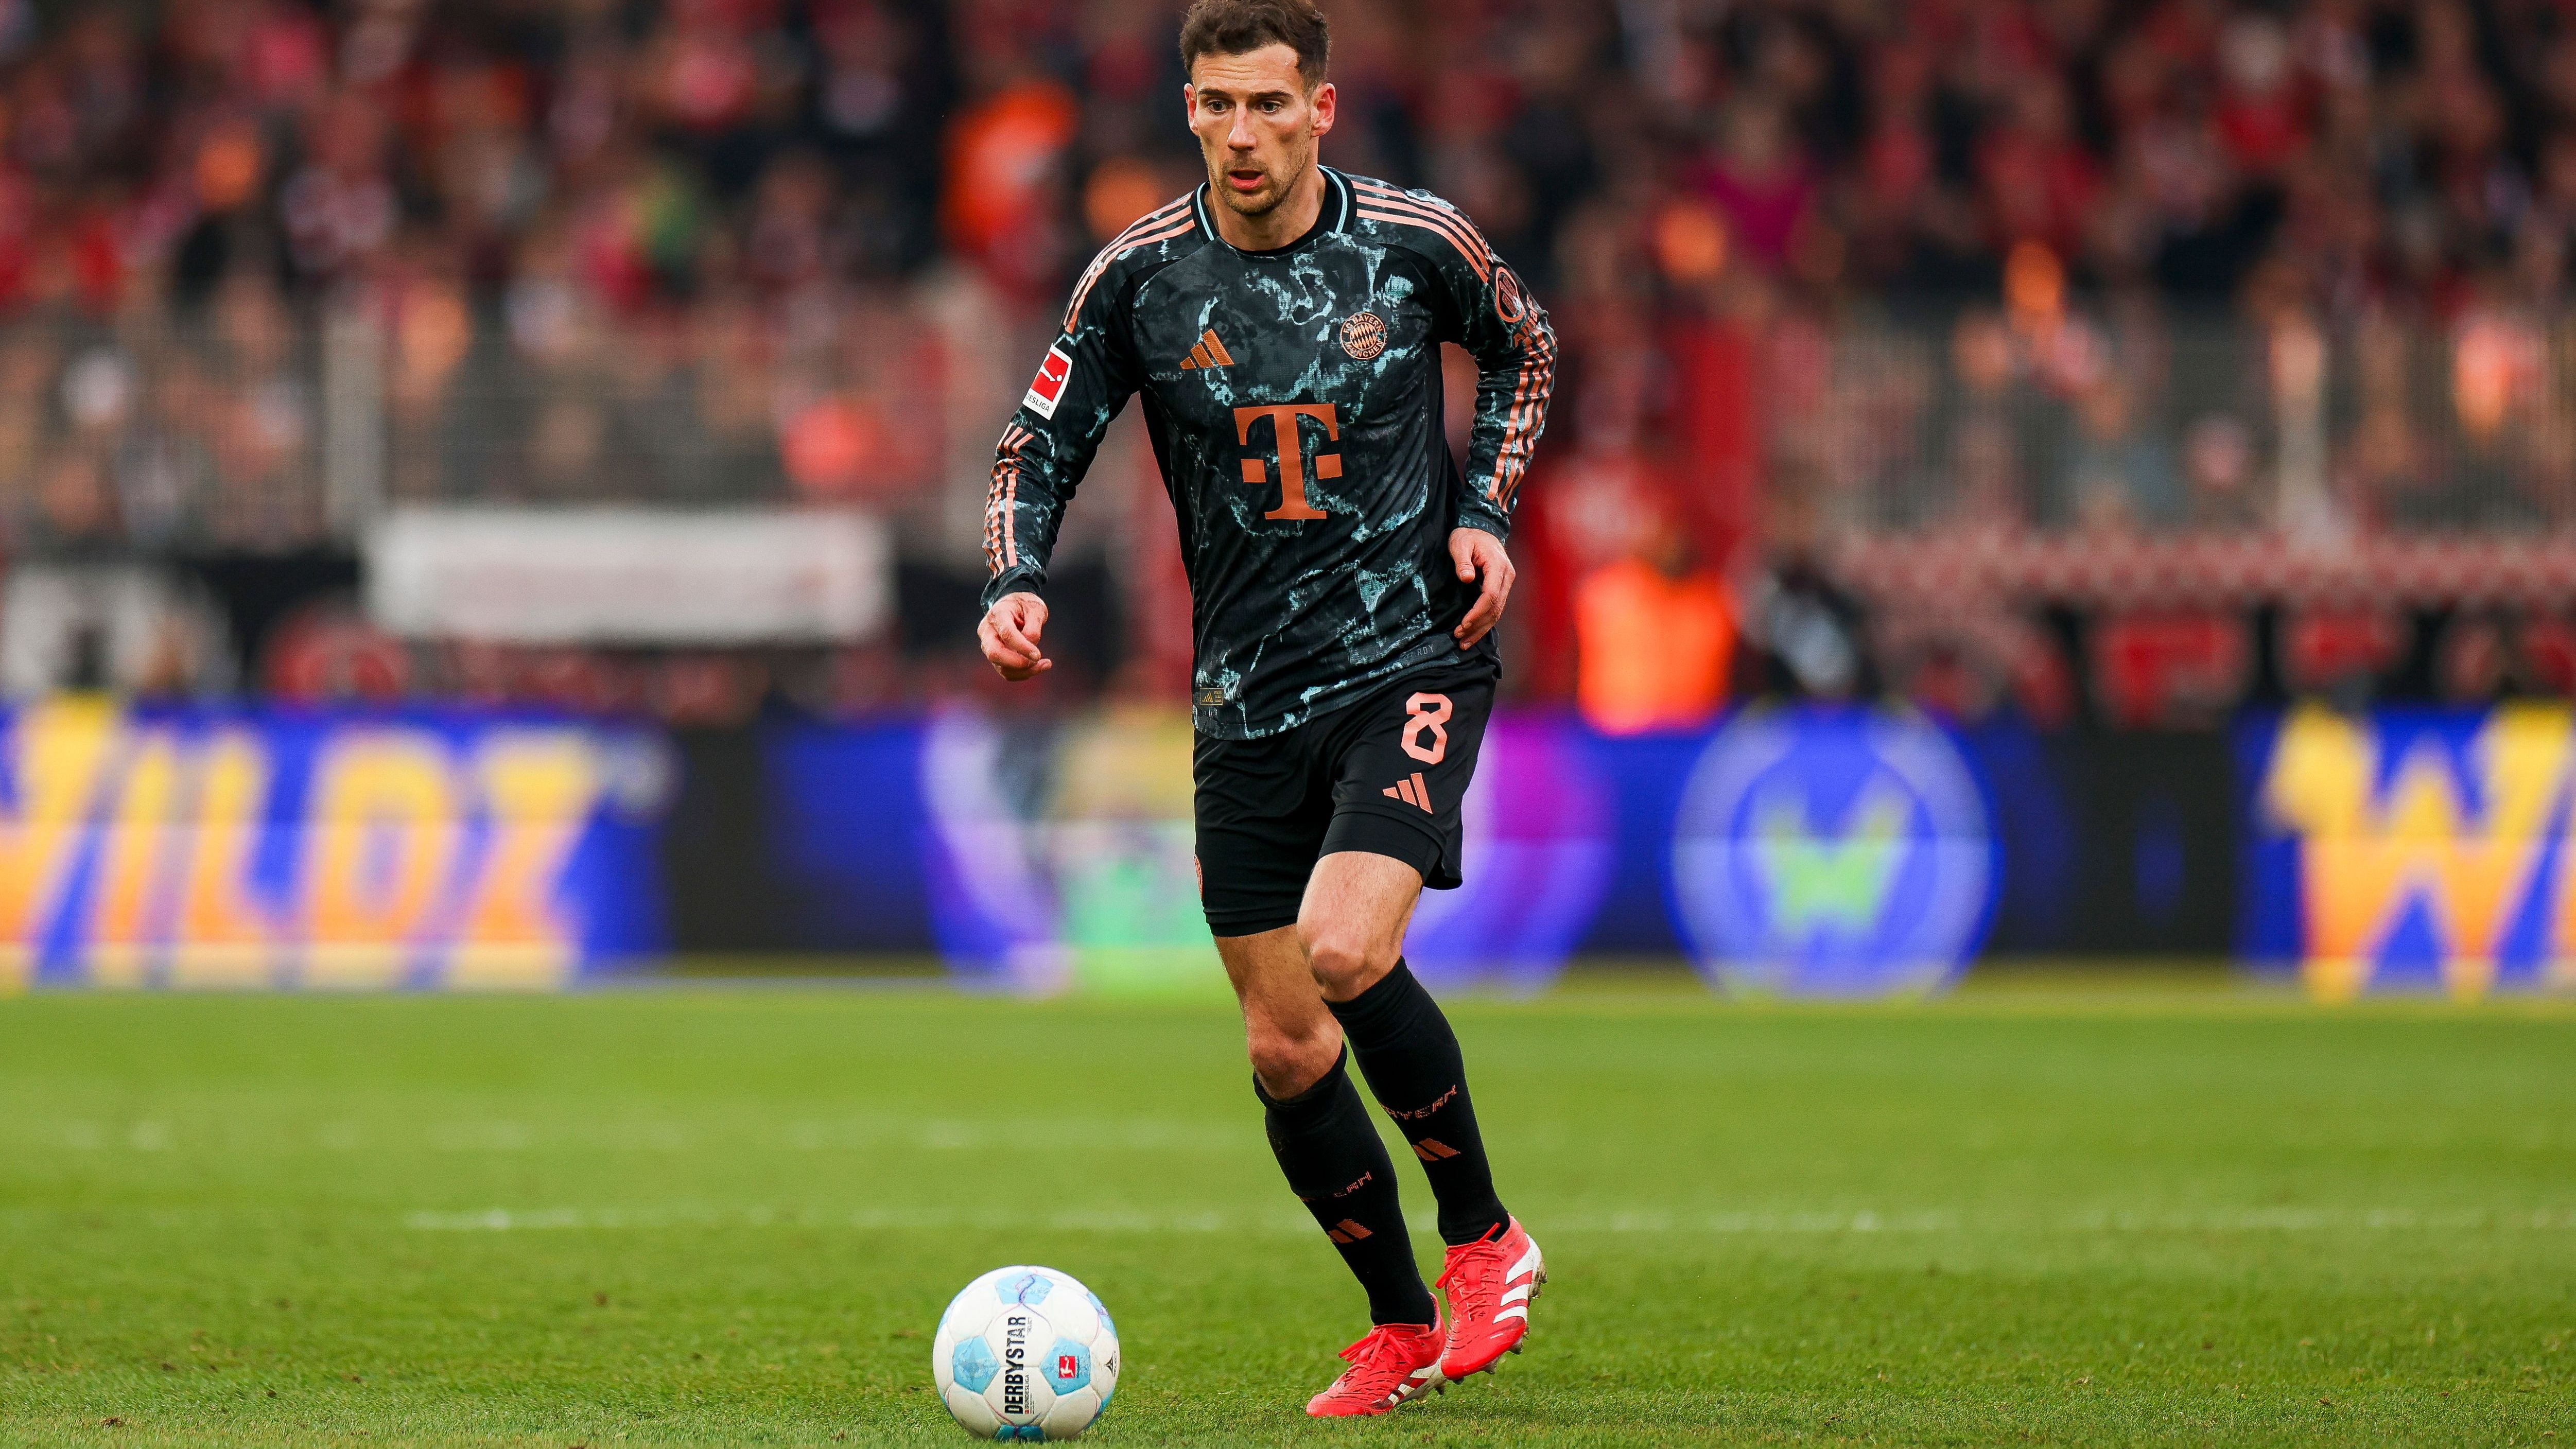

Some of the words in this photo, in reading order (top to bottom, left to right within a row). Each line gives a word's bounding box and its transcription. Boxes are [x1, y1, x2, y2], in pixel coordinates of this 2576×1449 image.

[1352, 315, 1383, 333] BAYERN
[1401, 692, 1453, 765] 8
[1004, 1316, 1026, 1415] DERBYSTAR
